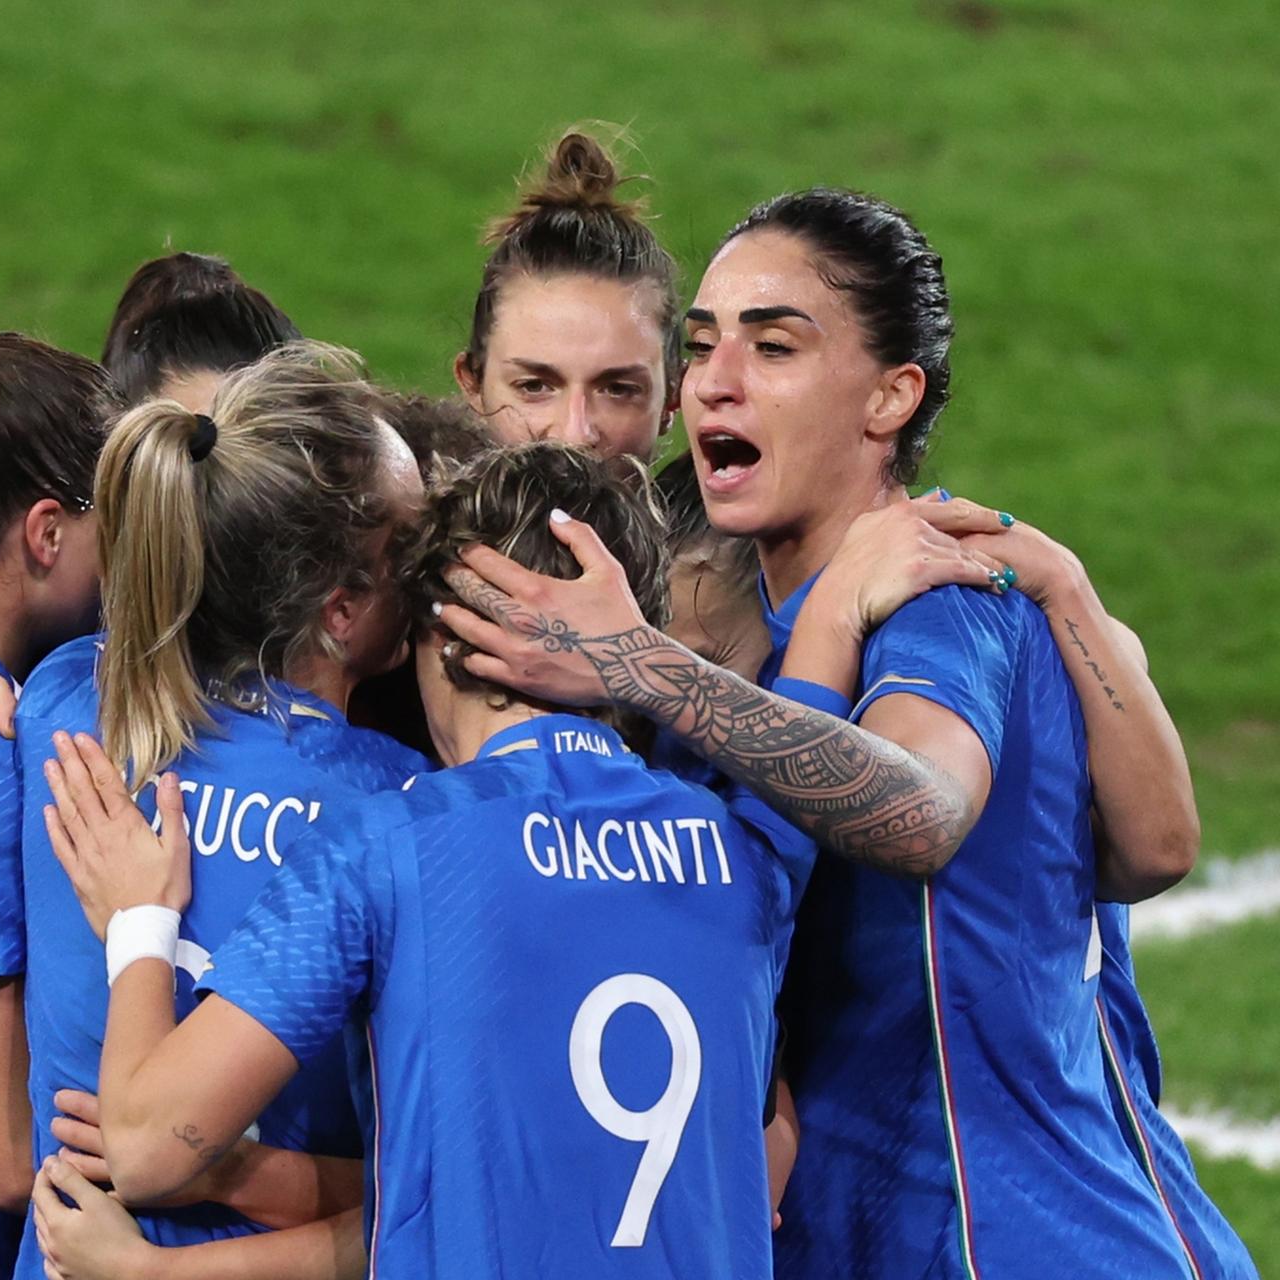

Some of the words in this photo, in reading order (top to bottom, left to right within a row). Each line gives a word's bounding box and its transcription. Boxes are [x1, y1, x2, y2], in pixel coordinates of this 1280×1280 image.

[554, 731, 612, 757] ITALIA
[523, 812, 732, 885] GIACINTI
[569, 973, 702, 1247] 9
